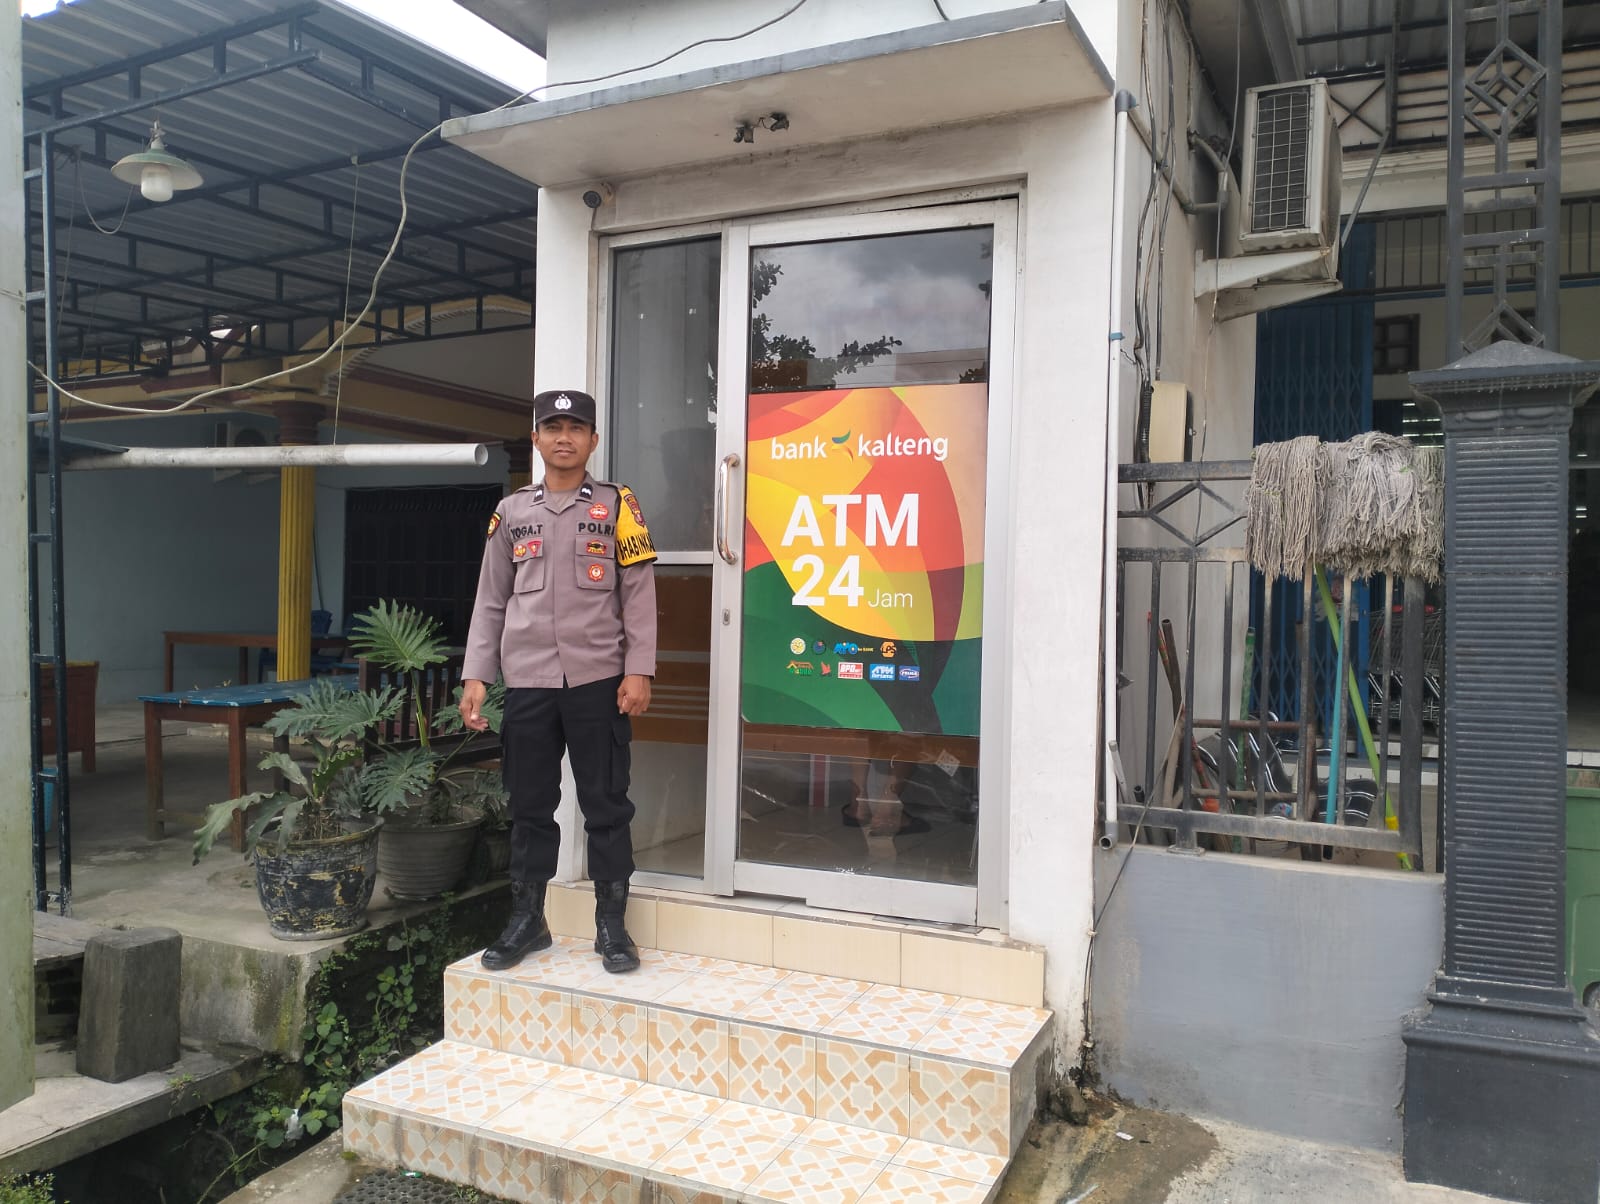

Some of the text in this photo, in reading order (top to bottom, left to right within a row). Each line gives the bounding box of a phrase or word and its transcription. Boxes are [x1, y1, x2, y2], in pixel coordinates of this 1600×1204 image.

[771, 432, 949, 462] bank kalteng
[510, 524, 544, 540] YOGA.T
[578, 522, 615, 536] POLRI
[780, 493, 920, 547] ATM
[791, 554, 913, 608] 24 Jam
